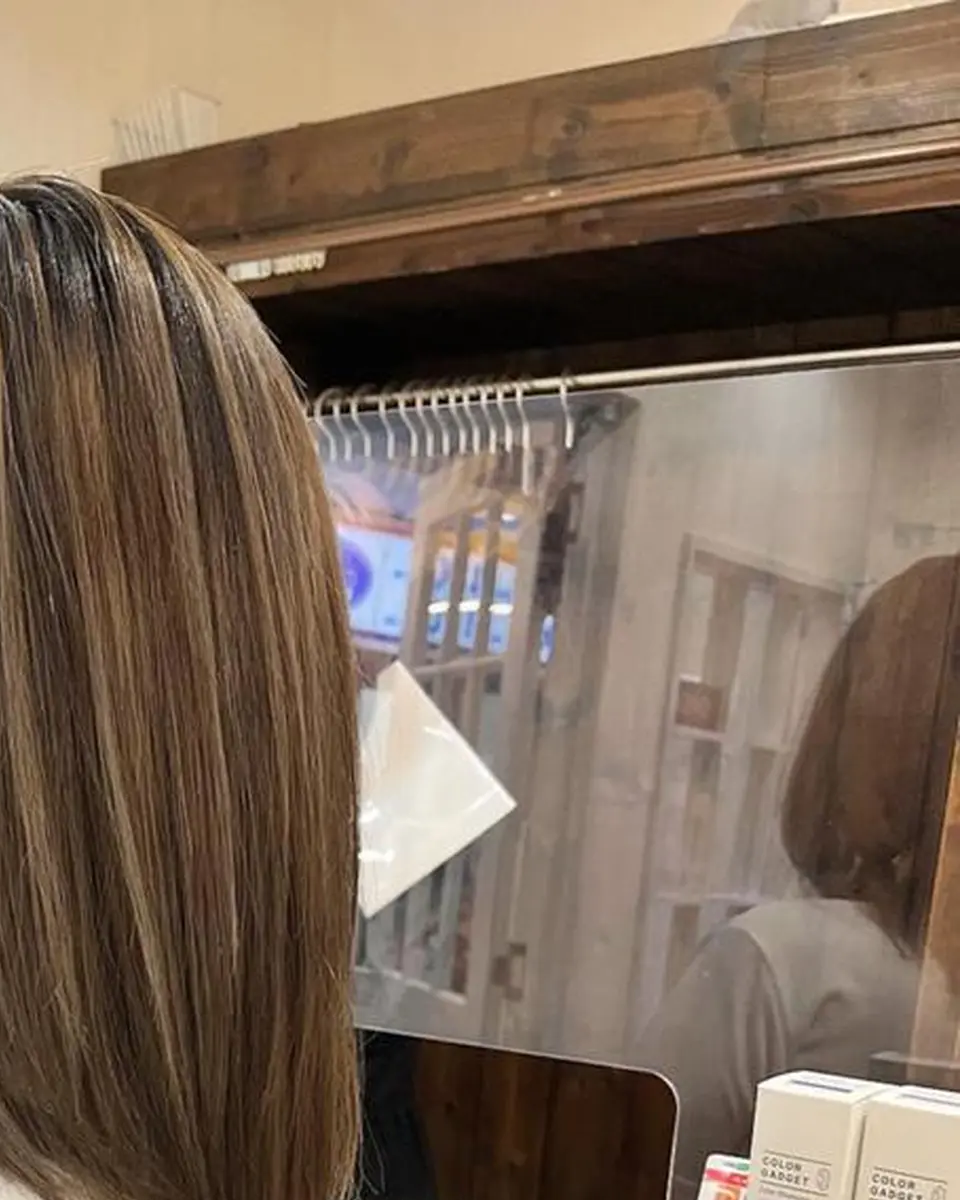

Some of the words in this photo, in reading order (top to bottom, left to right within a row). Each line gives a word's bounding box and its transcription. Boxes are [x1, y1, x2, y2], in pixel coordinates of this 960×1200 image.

[761, 1156, 803, 1171] COLOR
[760, 1168, 811, 1186] GADGET
[871, 1173, 916, 1189] COLOR
